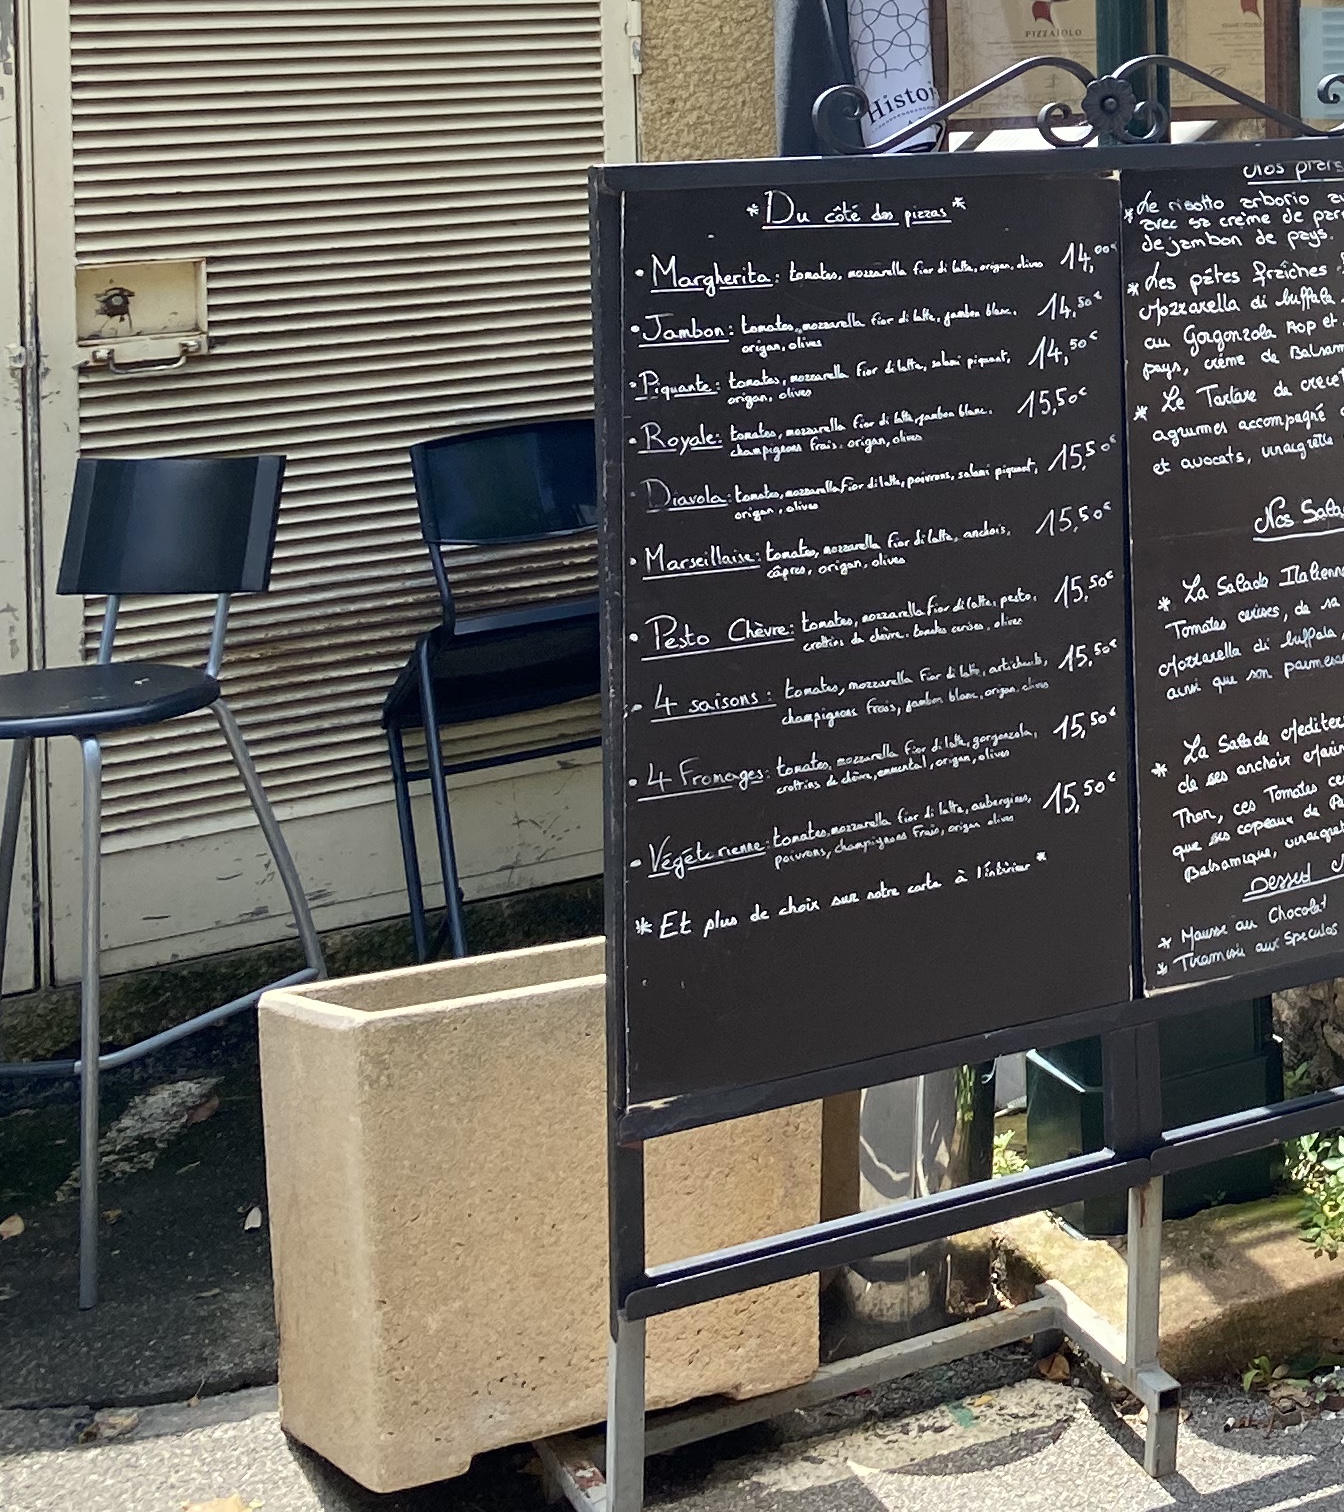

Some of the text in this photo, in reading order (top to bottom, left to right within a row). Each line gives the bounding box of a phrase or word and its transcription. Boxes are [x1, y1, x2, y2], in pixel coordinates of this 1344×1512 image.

[764, 191, 810, 224] Du
[825, 205, 860, 223] côté
[905, 208, 947, 226] pizzas
[1137, 191, 1159, 215] Le
[1169, 195, 1224, 211] risotto
[1240, 190, 1309, 208] arborio
[1255, 497, 1296, 537] Nos
[645, 615, 711, 652] Pesto
[655, 684, 677, 715] 4
[648, 763, 672, 790] 4
[1256, 938, 1279, 952] aux
[1284, 923, 1337, 946] Speculos
